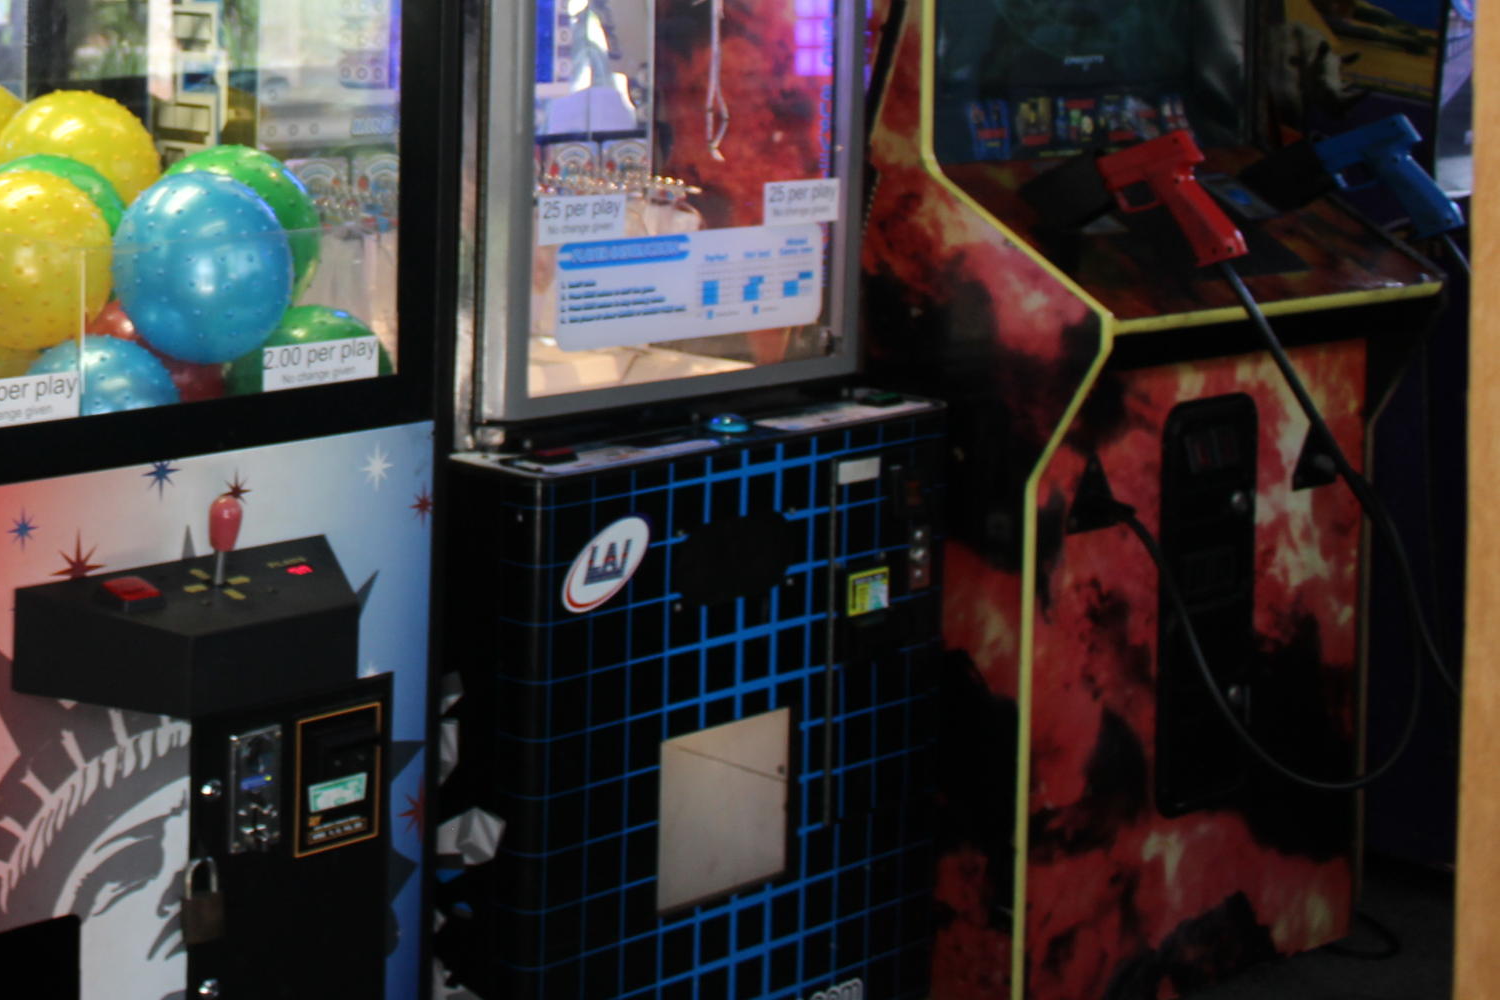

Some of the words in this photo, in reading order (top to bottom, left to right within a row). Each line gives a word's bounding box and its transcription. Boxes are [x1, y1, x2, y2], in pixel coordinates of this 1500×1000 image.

[788, 187, 810, 205] per
[811, 183, 836, 202] play
[564, 202, 588, 221] per
[592, 198, 621, 219] play
[263, 346, 302, 370] 2.00
[307, 344, 336, 367] per
[340, 339, 375, 363] play
[35, 375, 78, 401] play
[25, 404, 54, 419] given
[583, 539, 632, 586] LAI
